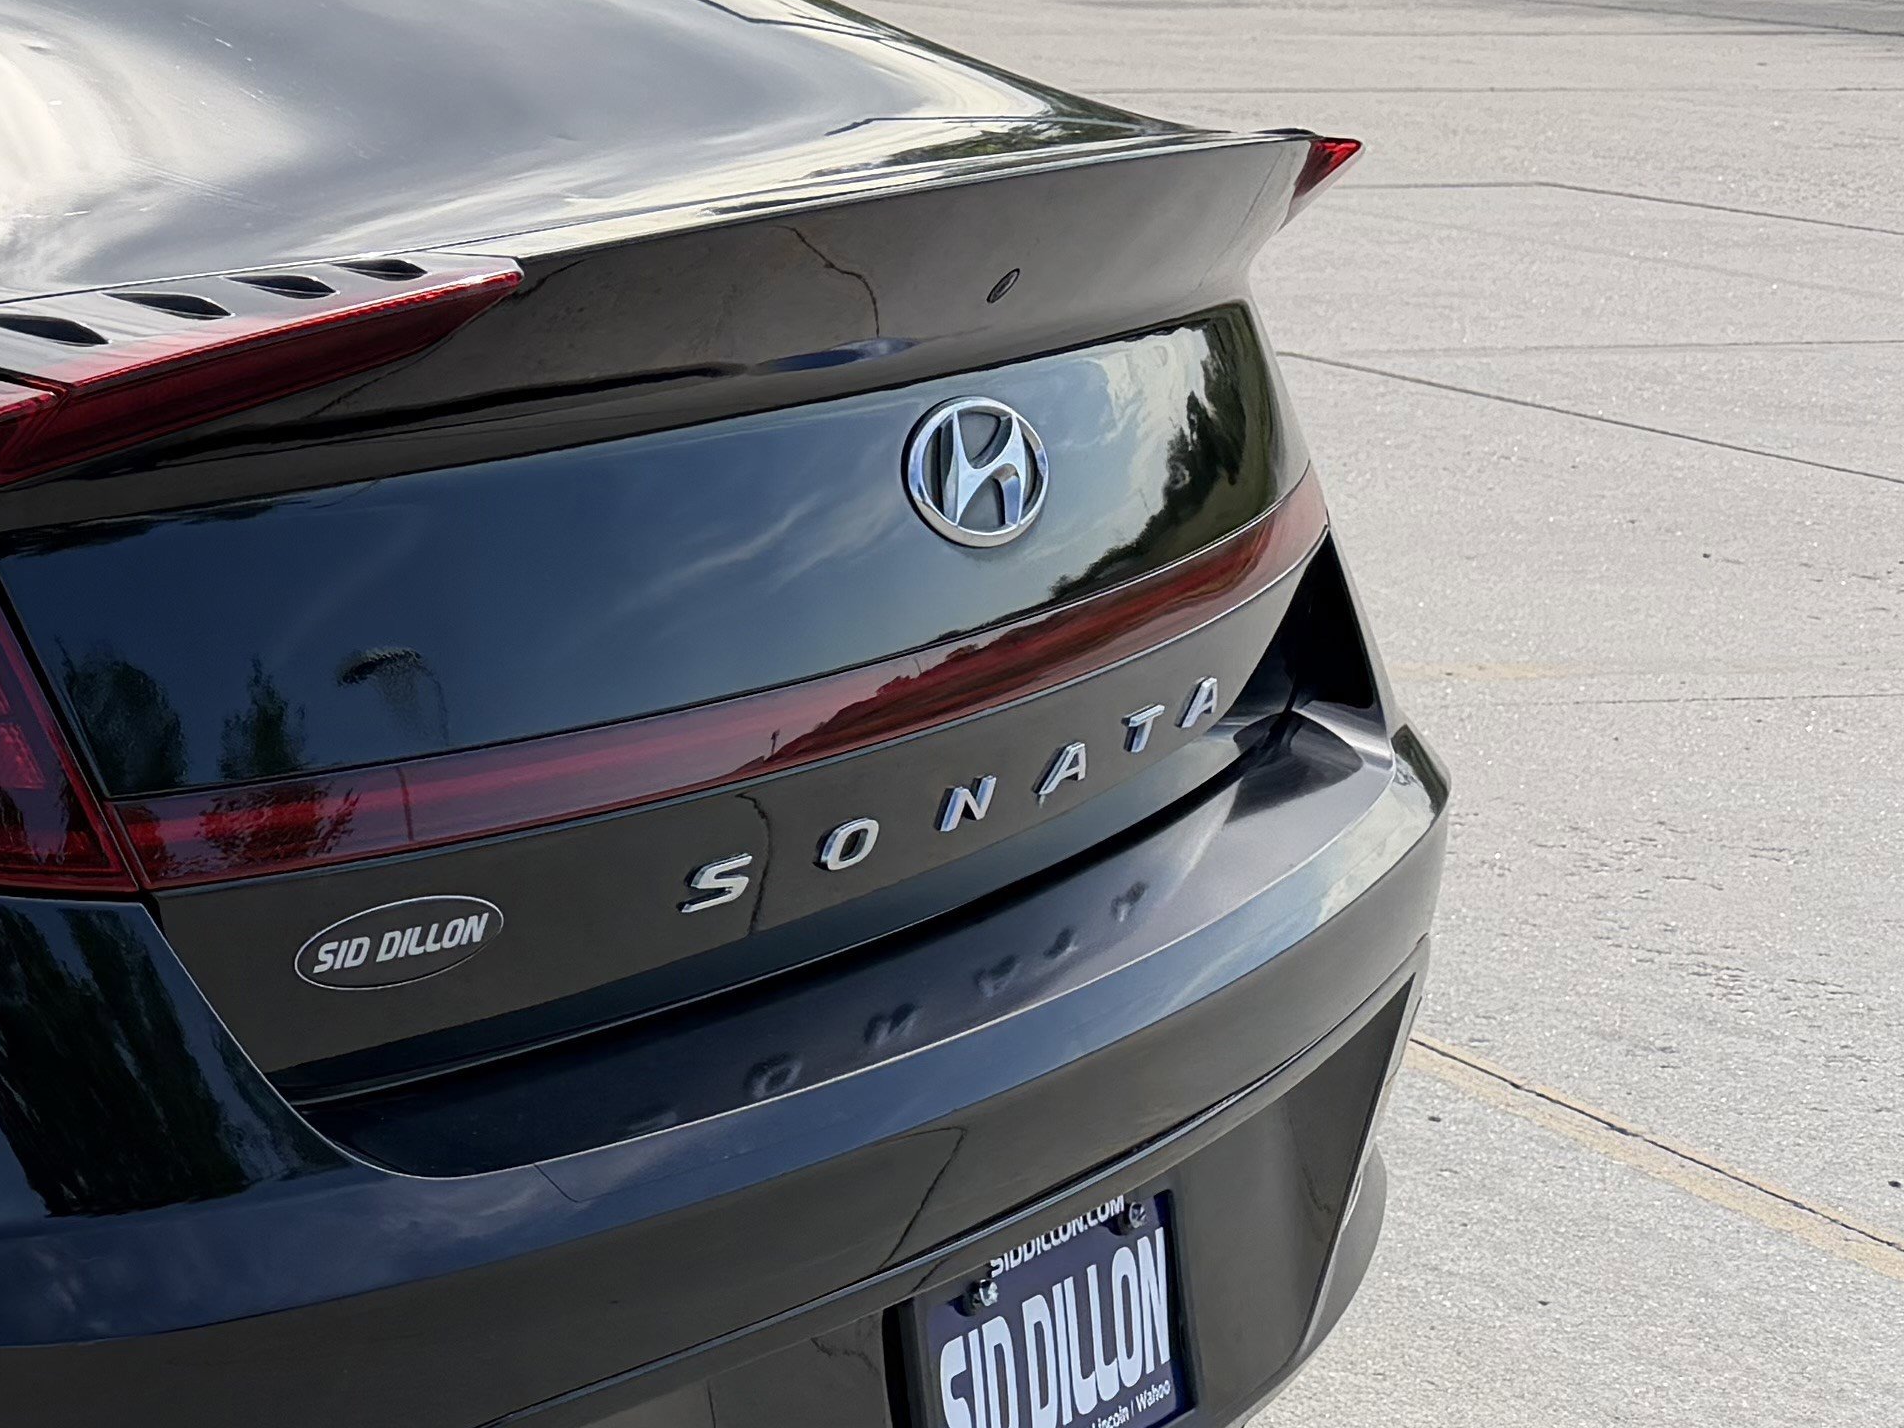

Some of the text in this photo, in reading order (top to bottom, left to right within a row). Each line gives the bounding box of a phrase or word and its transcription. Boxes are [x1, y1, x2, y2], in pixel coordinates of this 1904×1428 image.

[678, 676, 1218, 913] SONATA
[312, 912, 490, 974] SID DILLON
[1136, 1379, 1172, 1414] Wahoo
